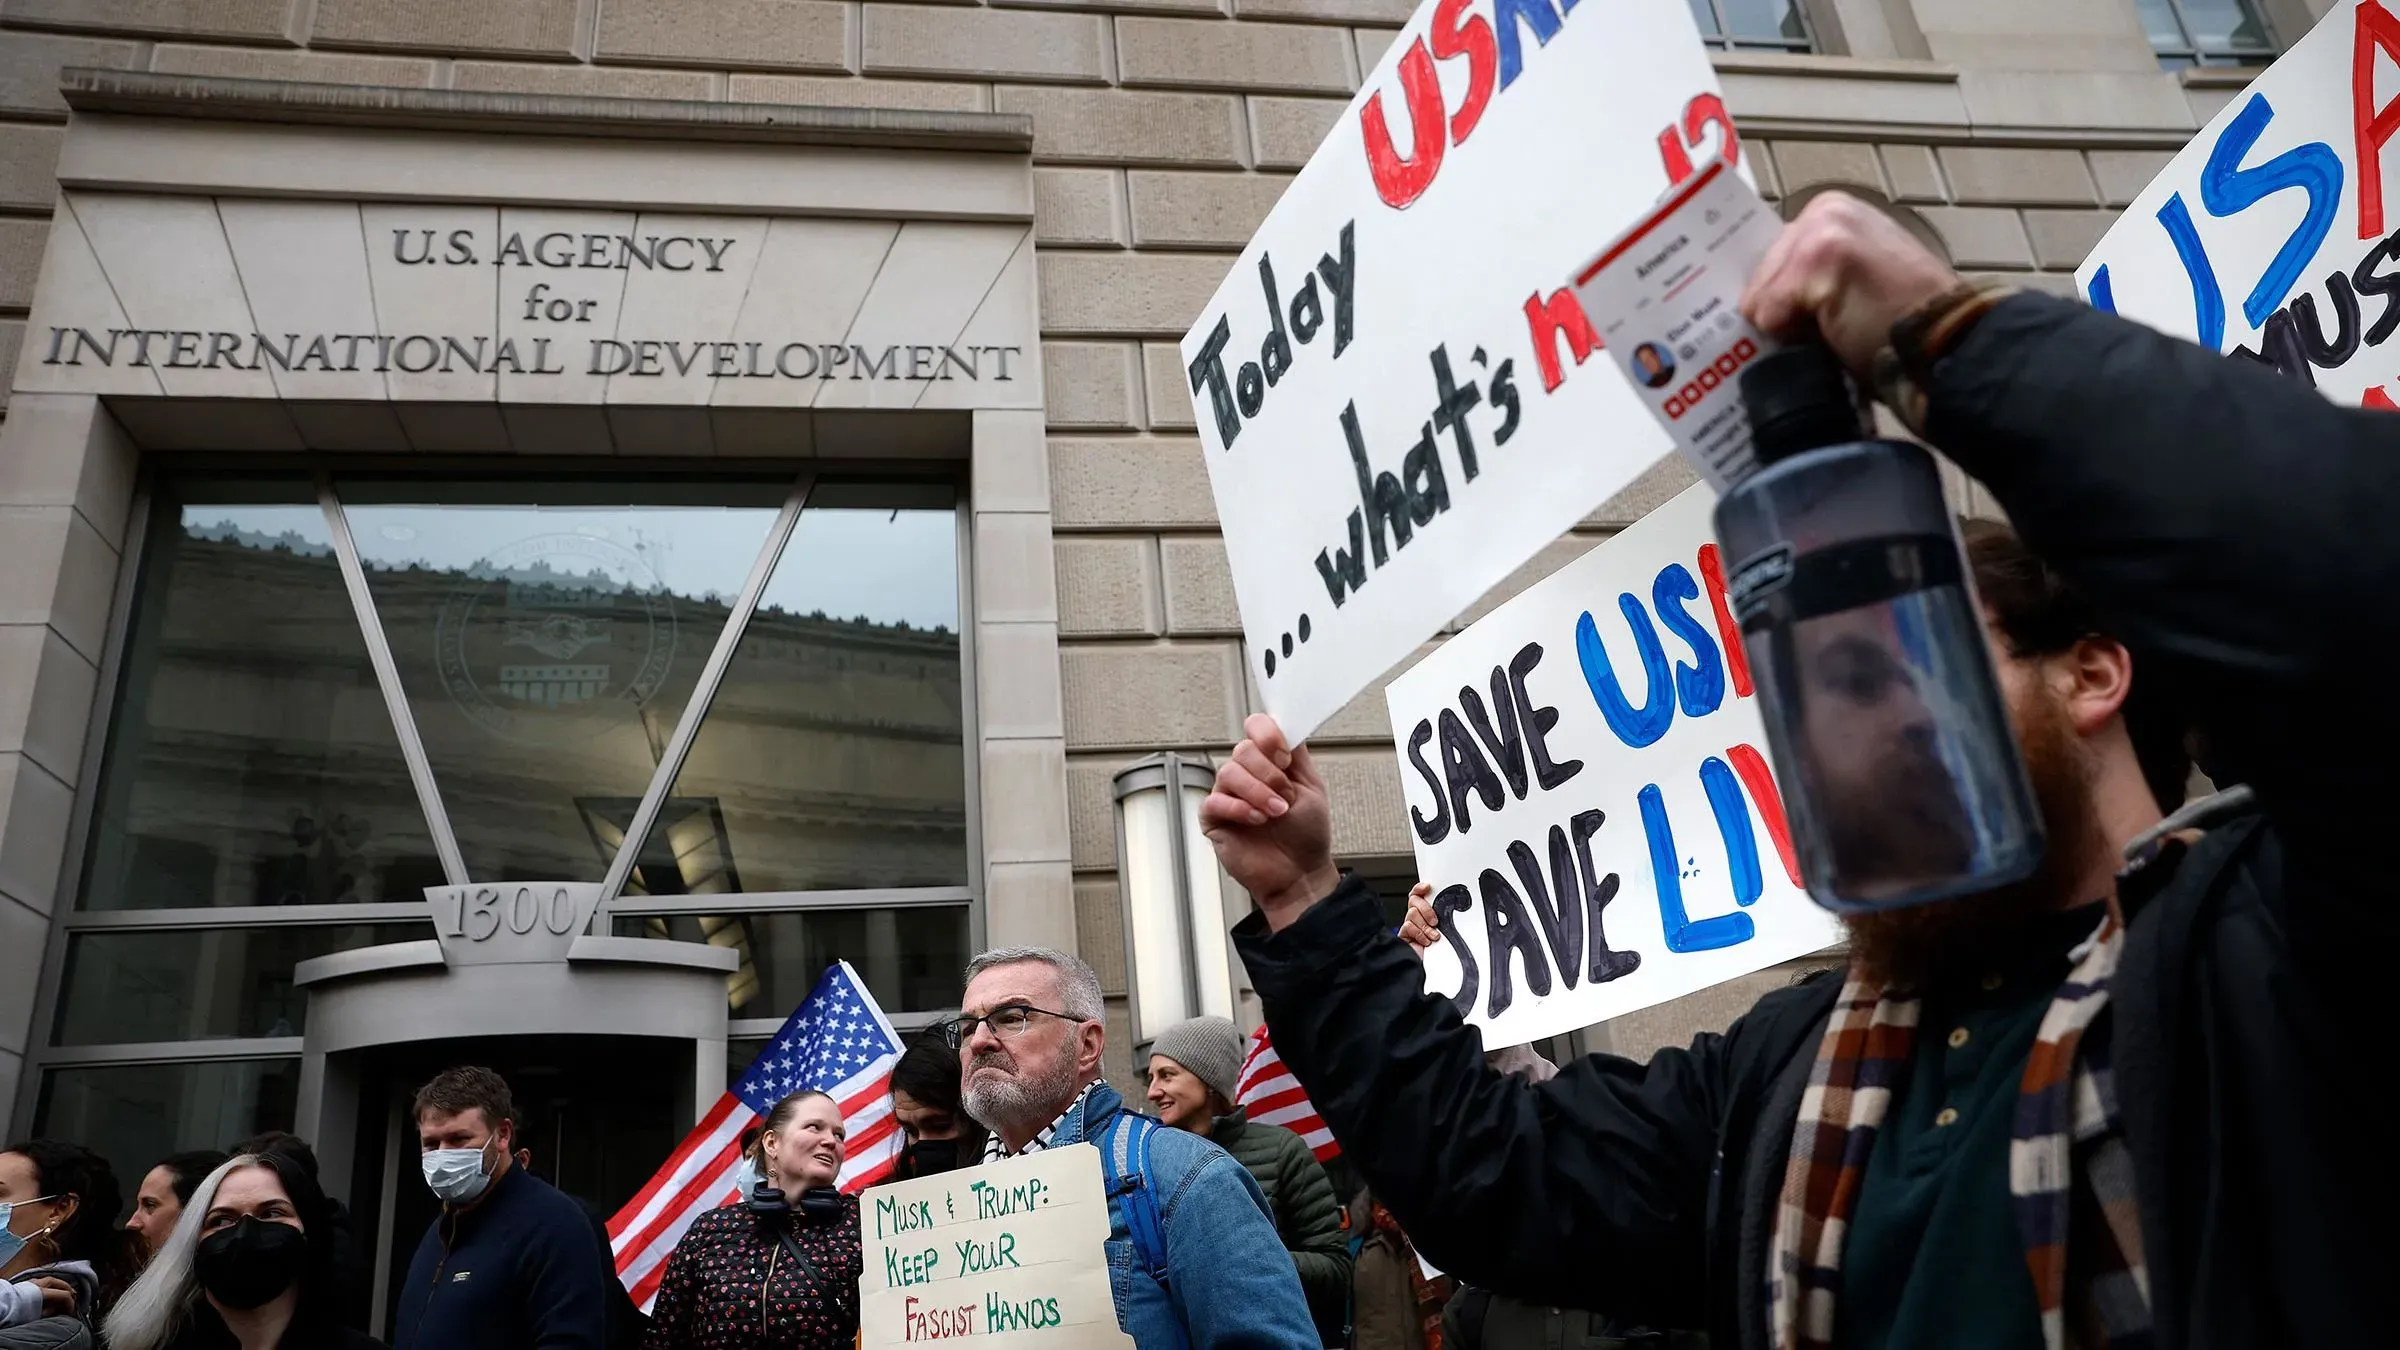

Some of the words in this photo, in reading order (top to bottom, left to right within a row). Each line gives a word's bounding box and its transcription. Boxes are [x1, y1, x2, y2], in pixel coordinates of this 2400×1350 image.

[392, 229, 479, 266] U.S.
[493, 231, 736, 273] AGENCY
[523, 284, 597, 322] for
[43, 326, 563, 375] INTERNATIONAL
[587, 339, 1021, 382] DEVELOPMENT
[1188, 219, 1355, 450] Today
[1314, 342, 1521, 609] what's
[1408, 642, 1585, 845] SAVE
[445, 886, 577, 943] 1300
[1432, 809, 1641, 1019] SAVE
[876, 1195, 933, 1240] MUSK
[970, 1178, 1049, 1220] TRUMP:
[885, 1246, 938, 1287] KEEP
[955, 1232, 1021, 1278] YOUR
[905, 1296, 977, 1343] FASCIST
[986, 1292, 1061, 1334] HANDS
